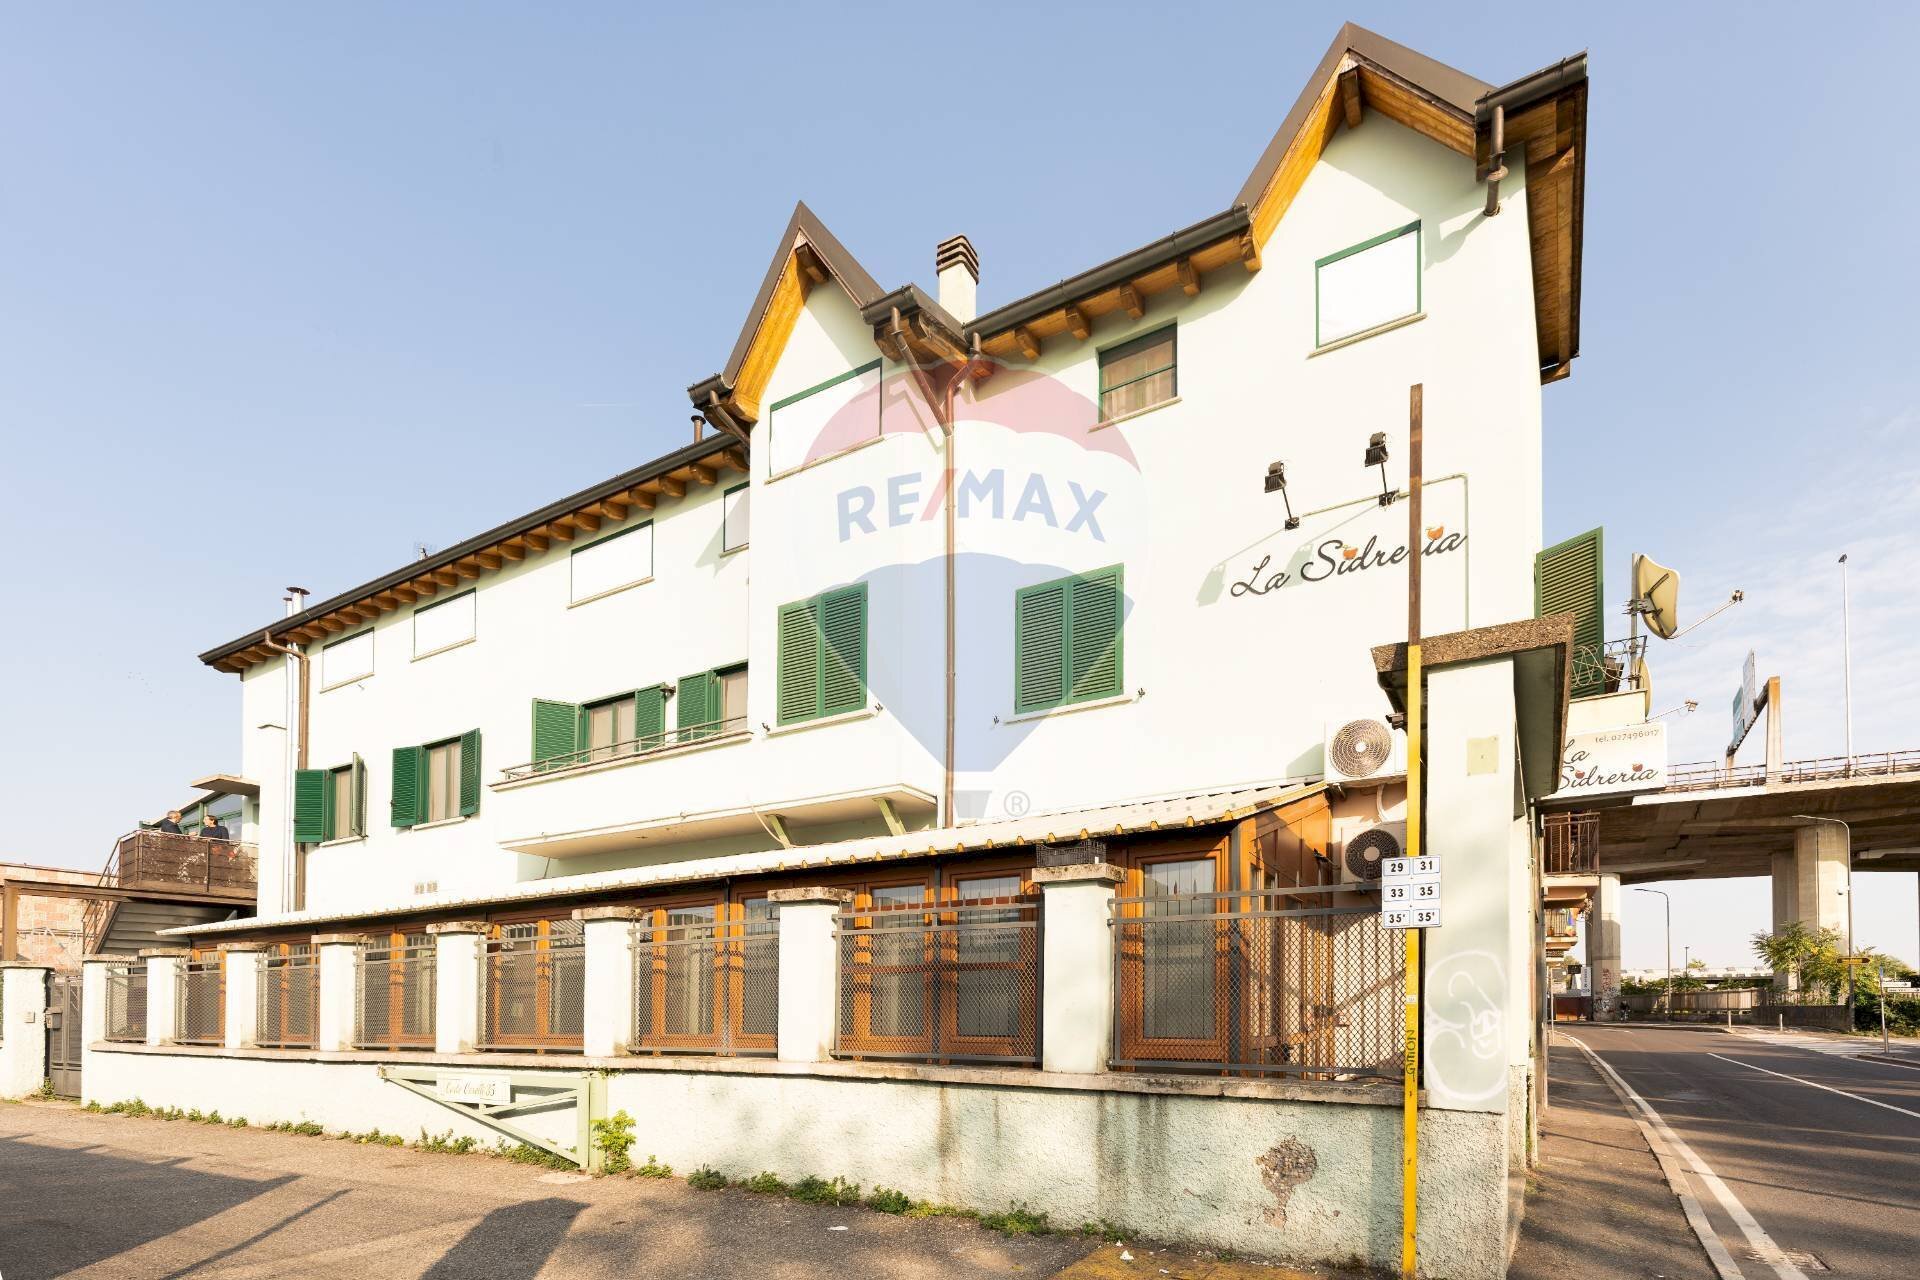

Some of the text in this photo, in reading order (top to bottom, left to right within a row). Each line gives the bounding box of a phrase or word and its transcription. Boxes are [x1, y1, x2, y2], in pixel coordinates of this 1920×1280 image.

[1230, 527, 1468, 597] La Sidreia
[1390, 860, 1433, 873] 29 31
[1390, 886, 1433, 898] 33 35
